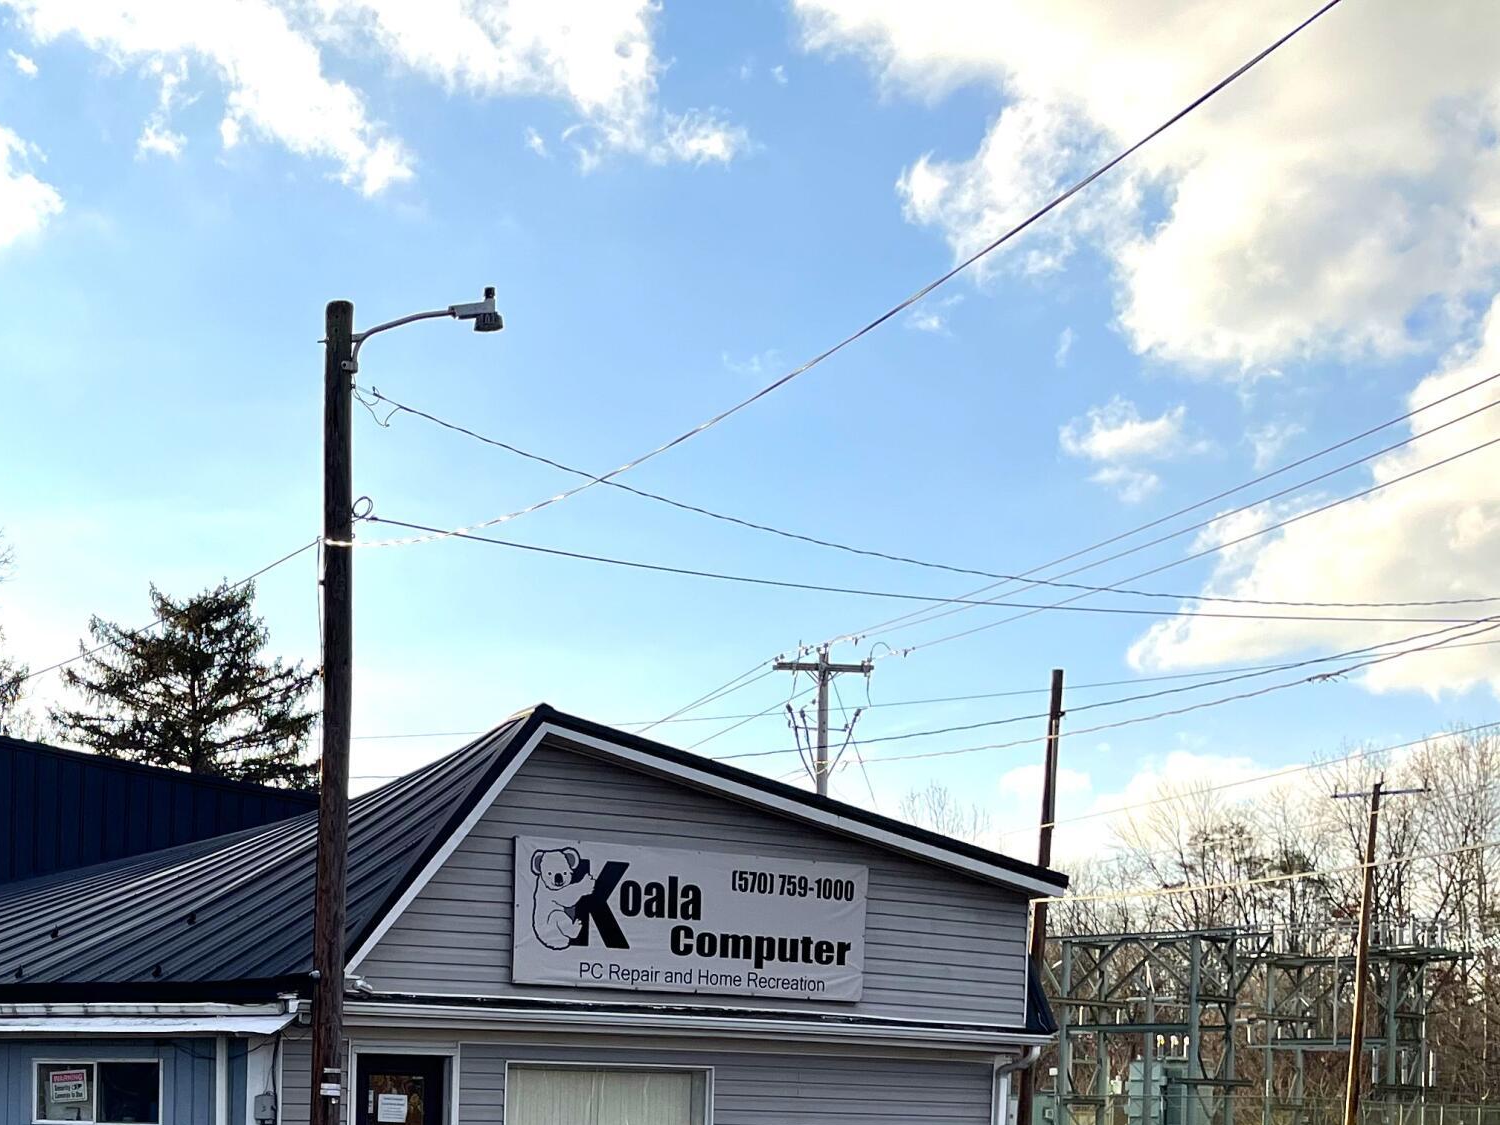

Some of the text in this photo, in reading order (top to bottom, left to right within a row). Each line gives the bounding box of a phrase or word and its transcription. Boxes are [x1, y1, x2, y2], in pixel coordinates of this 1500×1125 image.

[731, 869, 855, 902] (570) 759-1000
[569, 858, 702, 950] Koala
[670, 925, 851, 969] Computer
[578, 962, 826, 993] PC Repair and Home Recreation
[53, 1074, 82, 1082] WARNING
